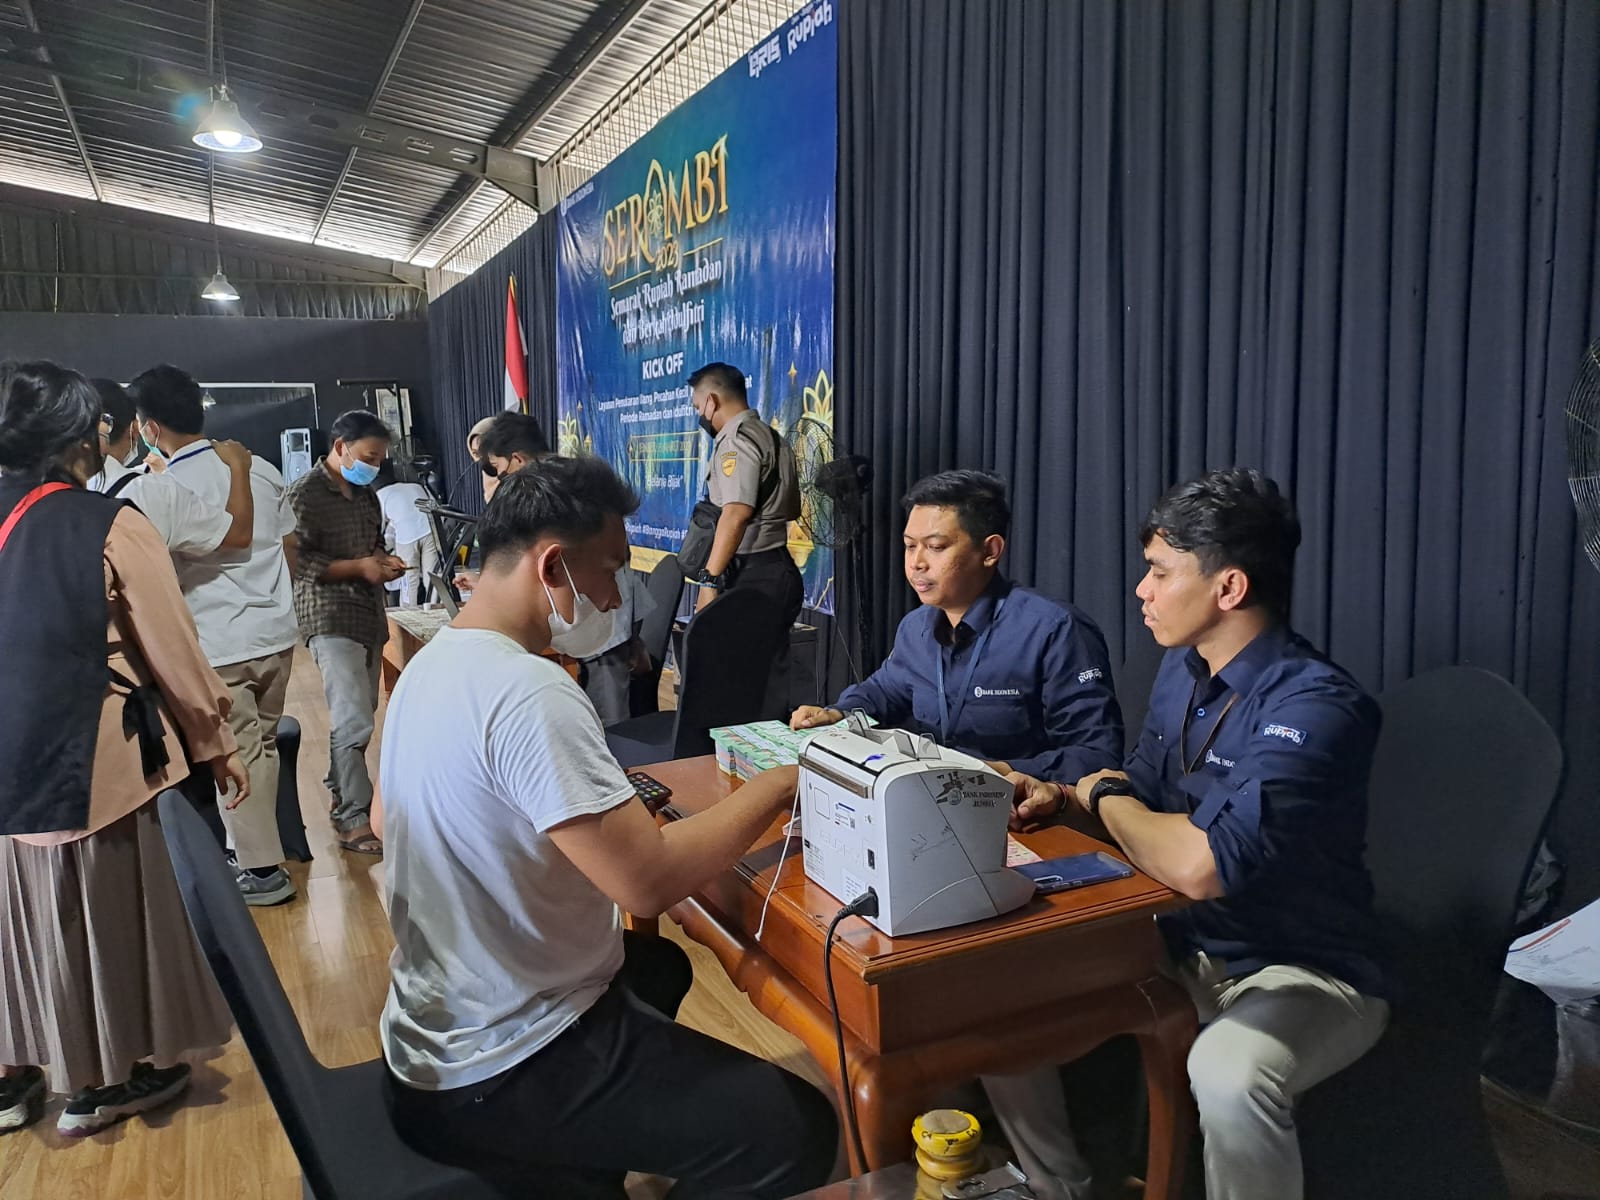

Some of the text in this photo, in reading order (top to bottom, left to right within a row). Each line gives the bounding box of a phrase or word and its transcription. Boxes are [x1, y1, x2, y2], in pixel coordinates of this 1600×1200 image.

[655, 240, 679, 272] 2023
[611, 257, 721, 320] Semarak Rupiah Ramadan
[642, 352, 684, 380] KICK OFF
[620, 412, 638, 423] Periode
[639, 408, 662, 421] Ramadan
[663, 407, 673, 419] dan
